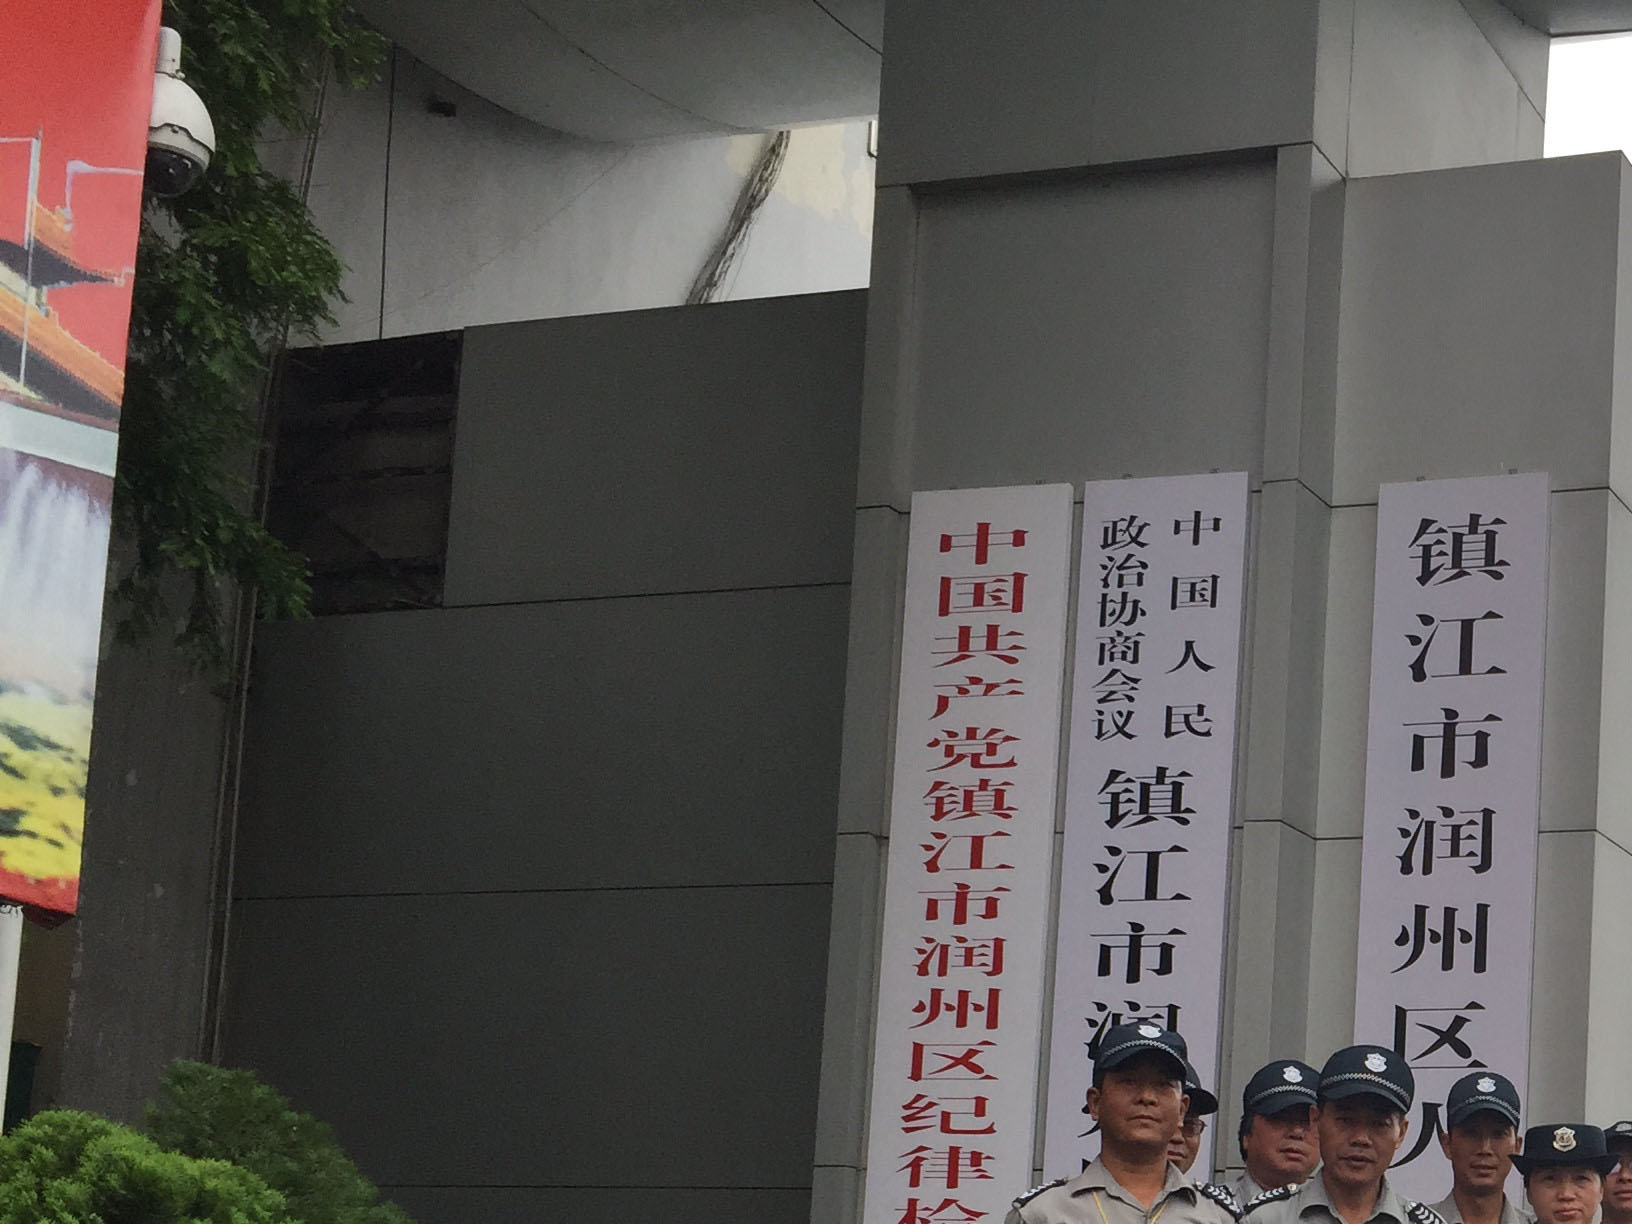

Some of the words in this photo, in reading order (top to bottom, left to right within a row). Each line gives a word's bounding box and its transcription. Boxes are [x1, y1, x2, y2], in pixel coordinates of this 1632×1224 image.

[1092, 515, 1151, 741] 政治协商会议
[1163, 511, 1223, 739] 中国人民
